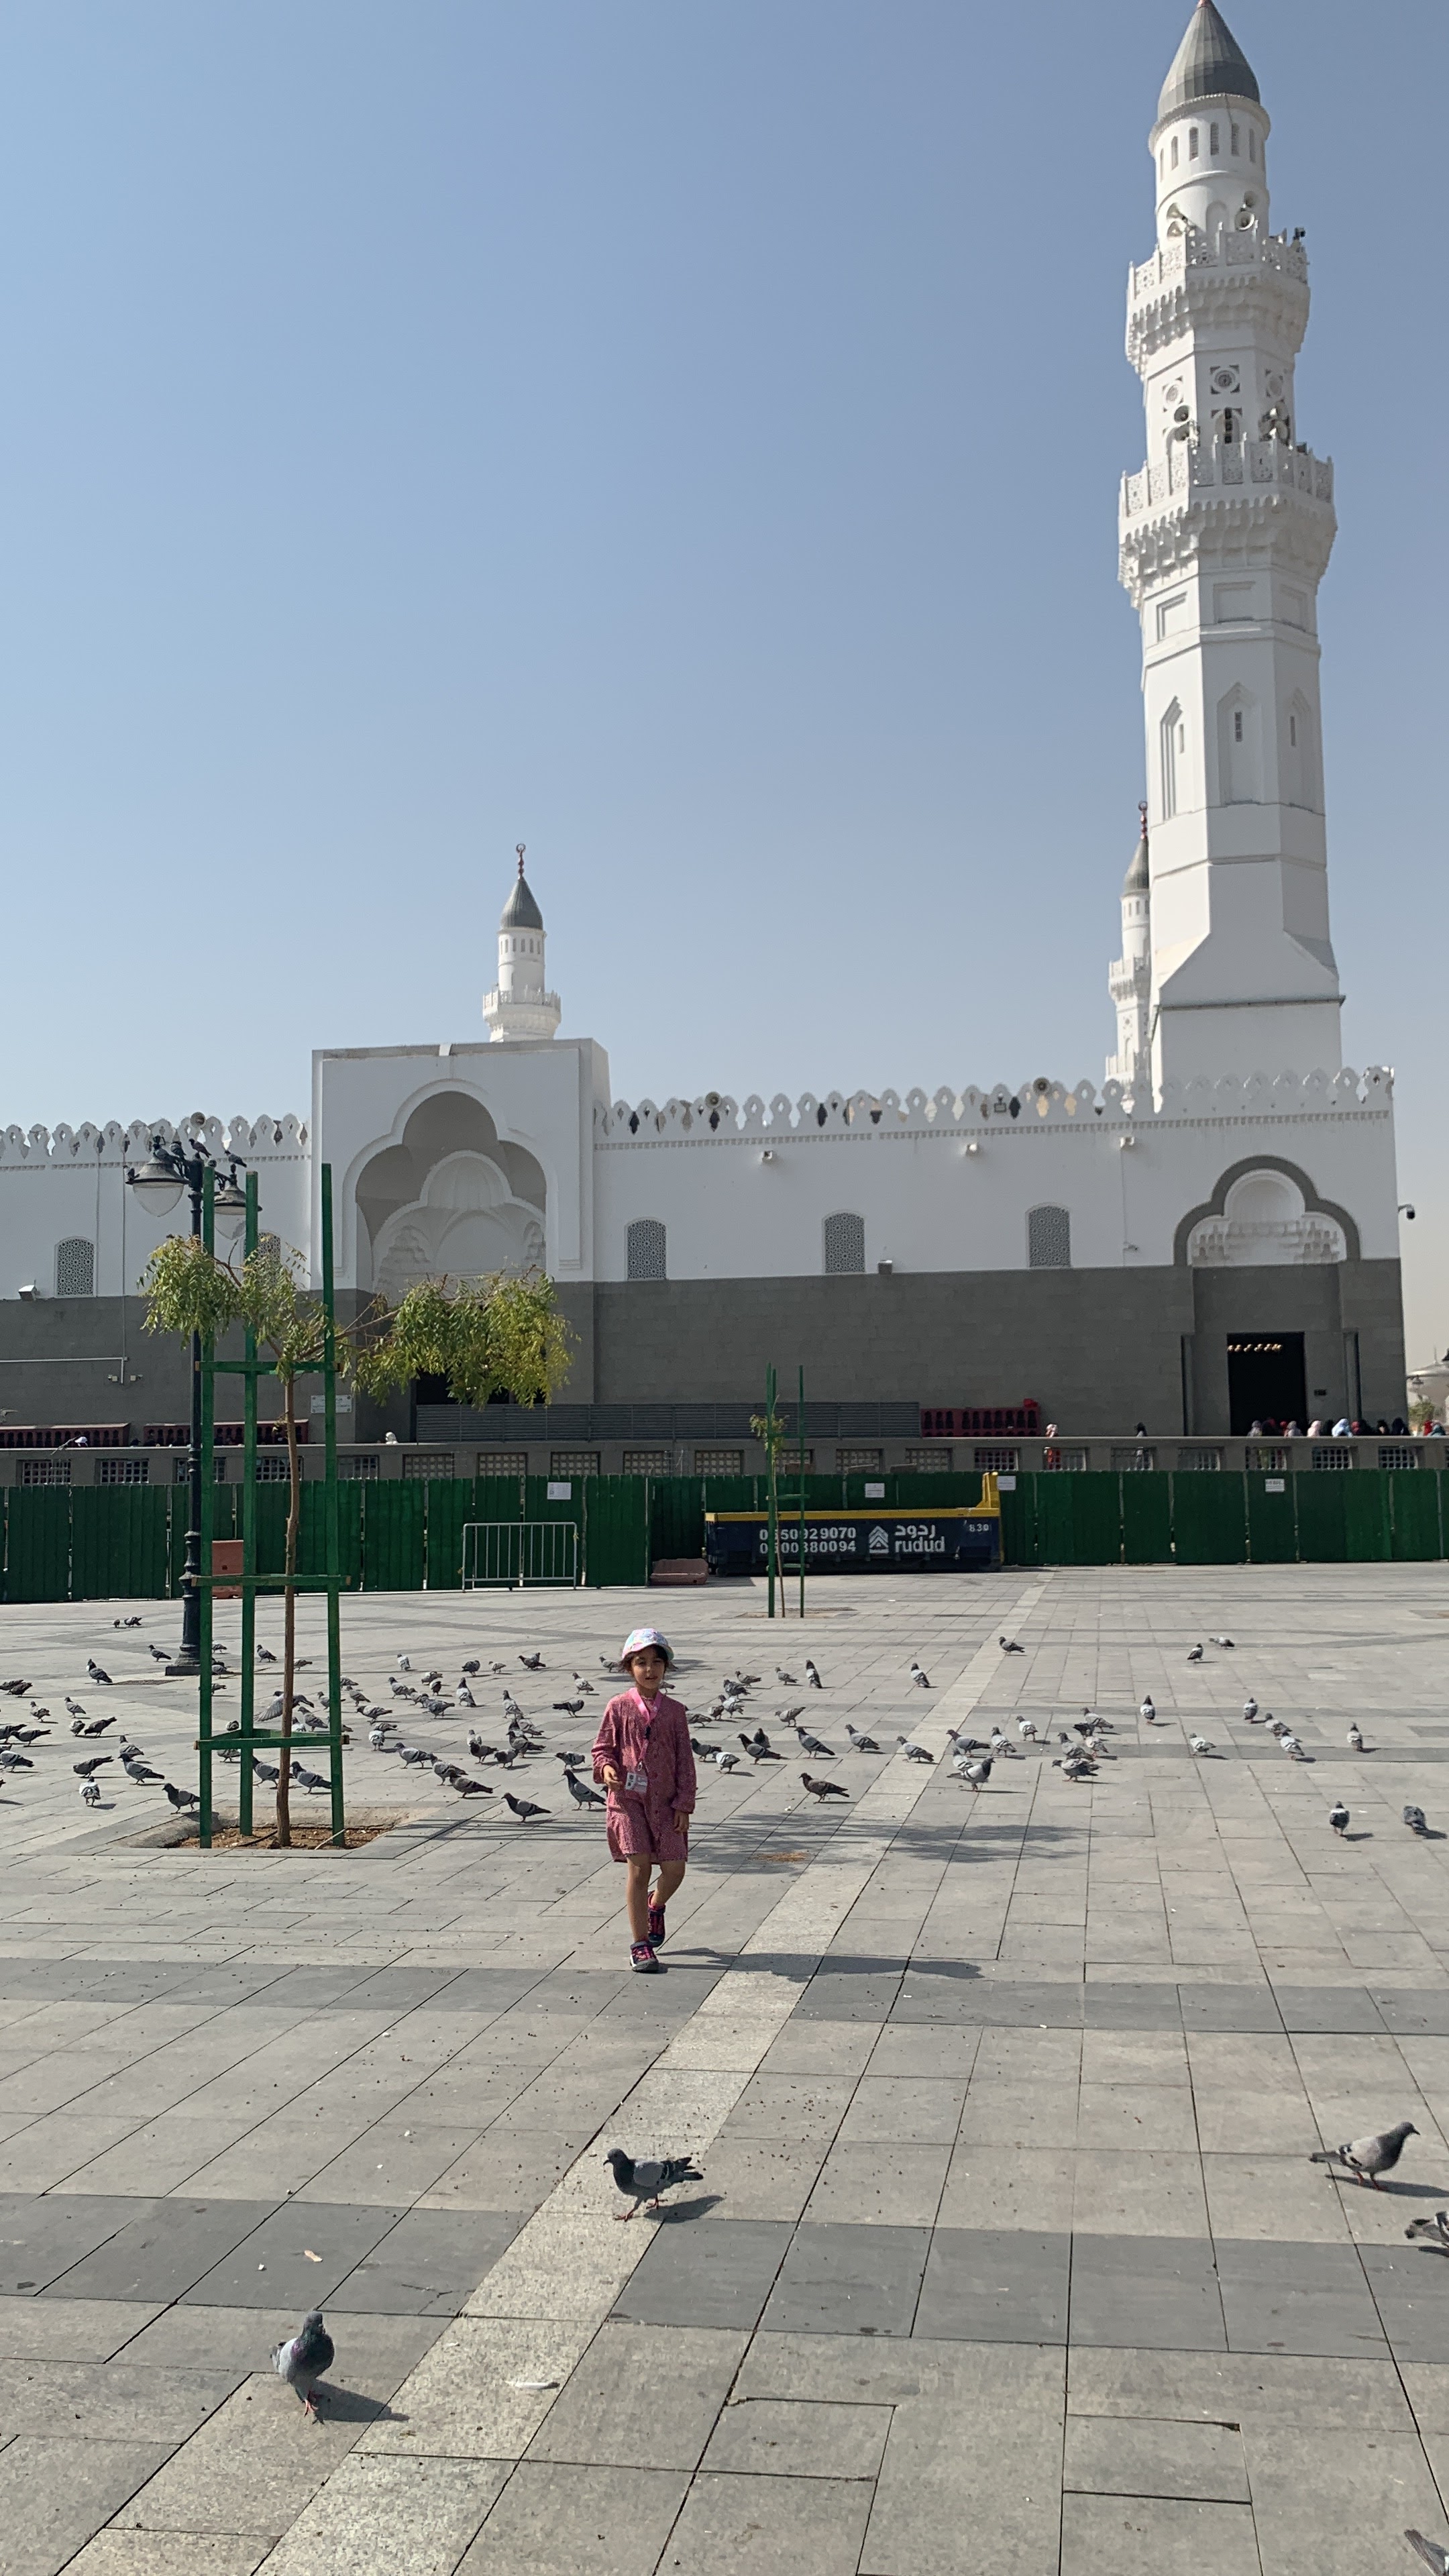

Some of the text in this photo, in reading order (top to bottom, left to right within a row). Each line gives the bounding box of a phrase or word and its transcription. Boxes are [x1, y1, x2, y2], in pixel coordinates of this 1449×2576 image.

[895, 1524, 936, 1538] ردود
[969, 1523, 989, 1532] 830
[895, 1536, 945, 1553] rudud
